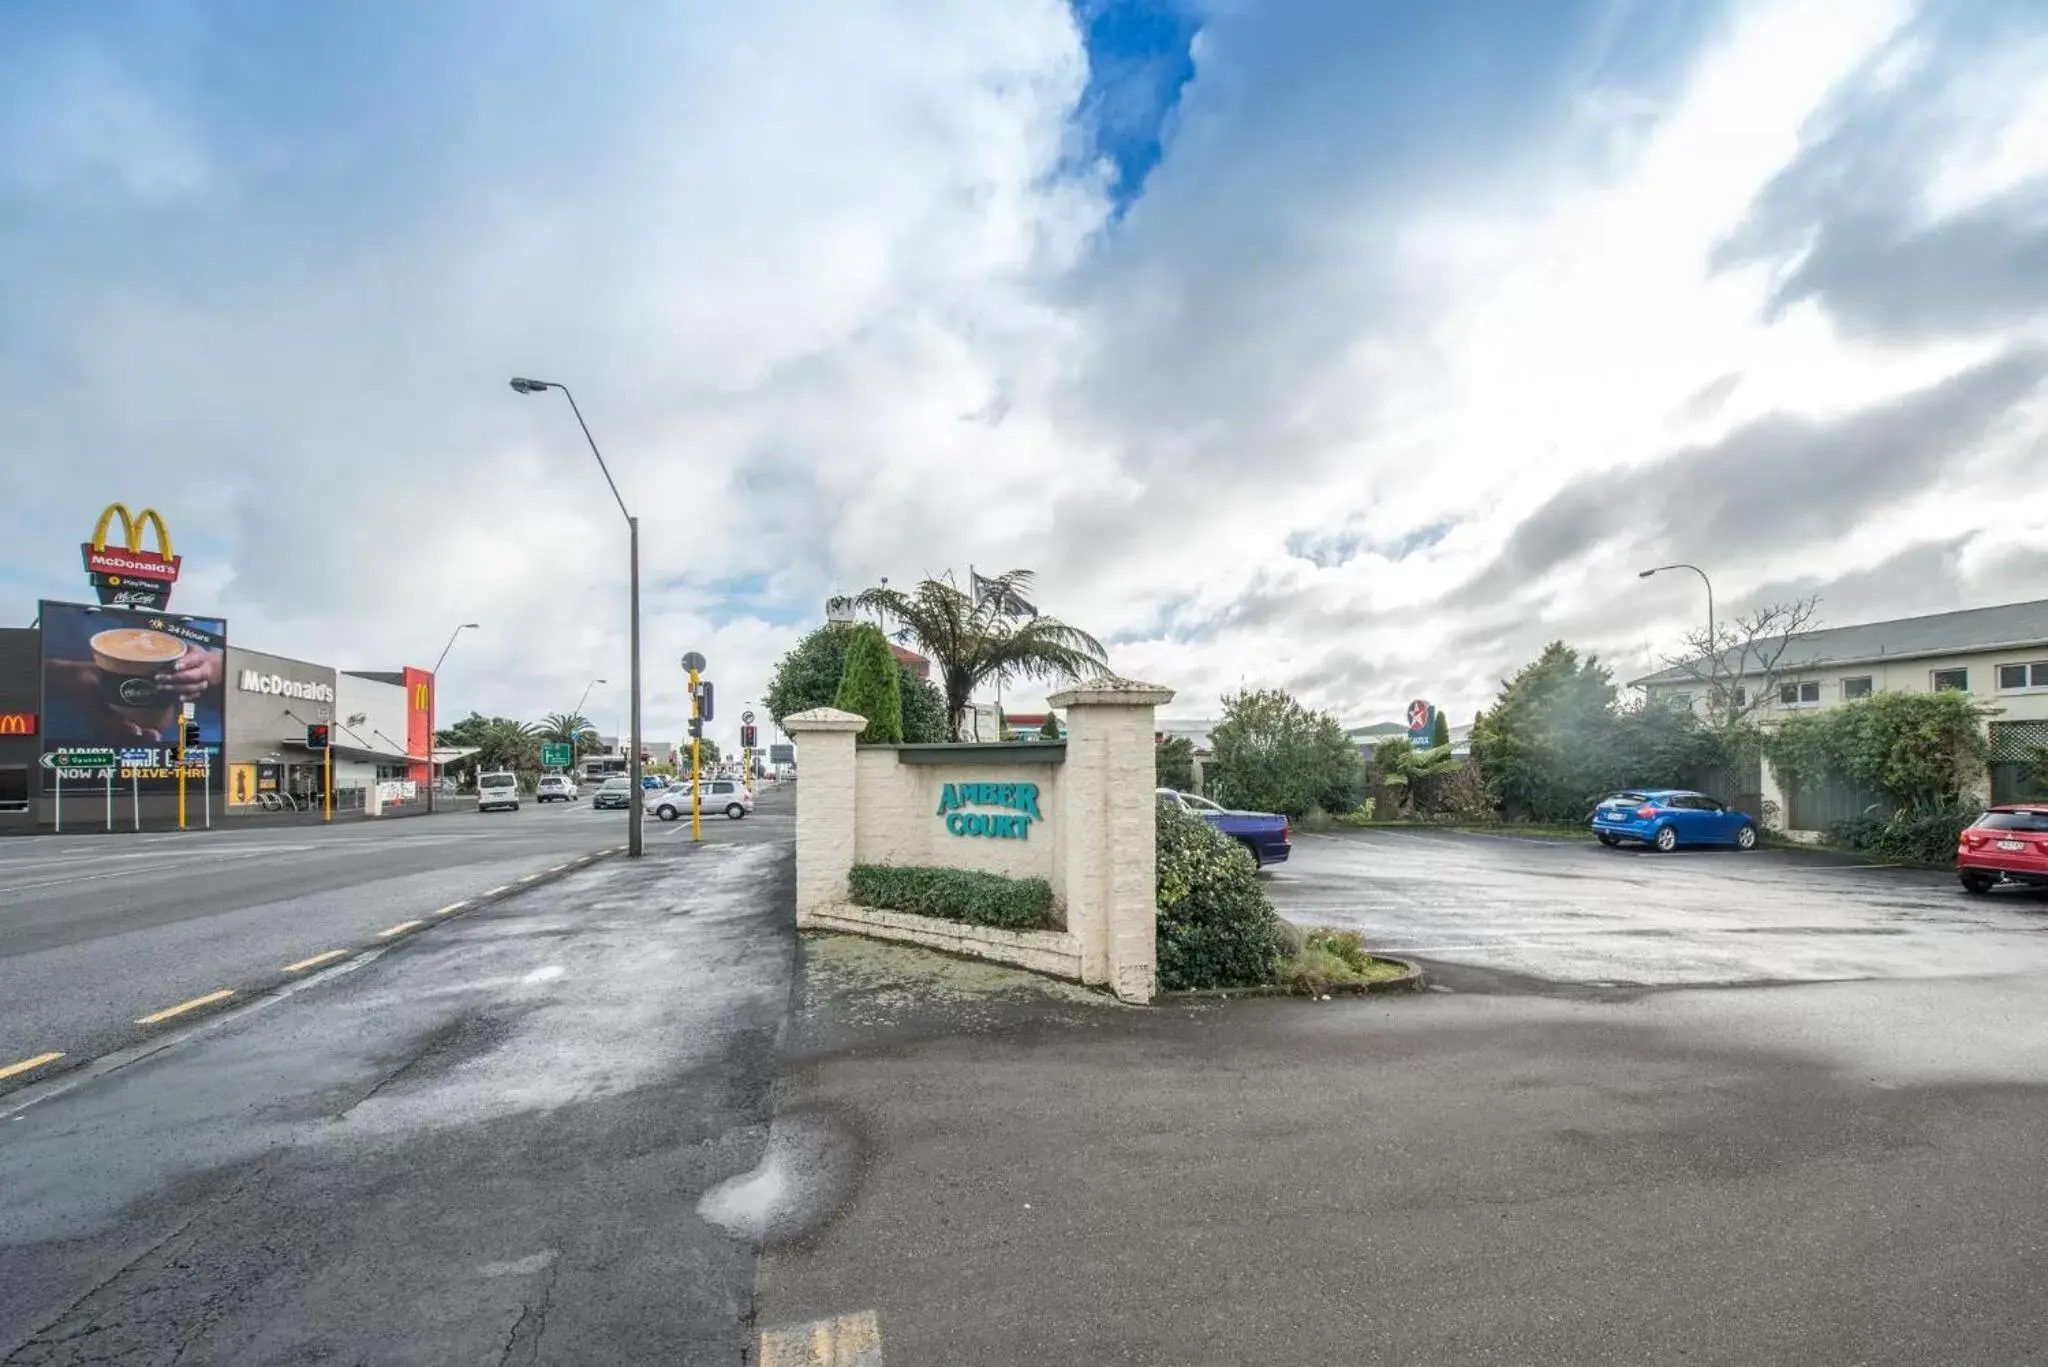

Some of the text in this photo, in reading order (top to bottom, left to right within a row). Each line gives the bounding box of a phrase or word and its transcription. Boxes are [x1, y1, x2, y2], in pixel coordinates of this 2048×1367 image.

[92, 555, 176, 575] McDonald's
[167, 624, 210, 643] 24 Hours
[240, 668, 334, 703] McDonald's
[57, 768, 93, 779] NOW
[97, 768, 116, 779] AT
[936, 783, 1045, 822] AMBER
[946, 812, 1033, 840] COURT
